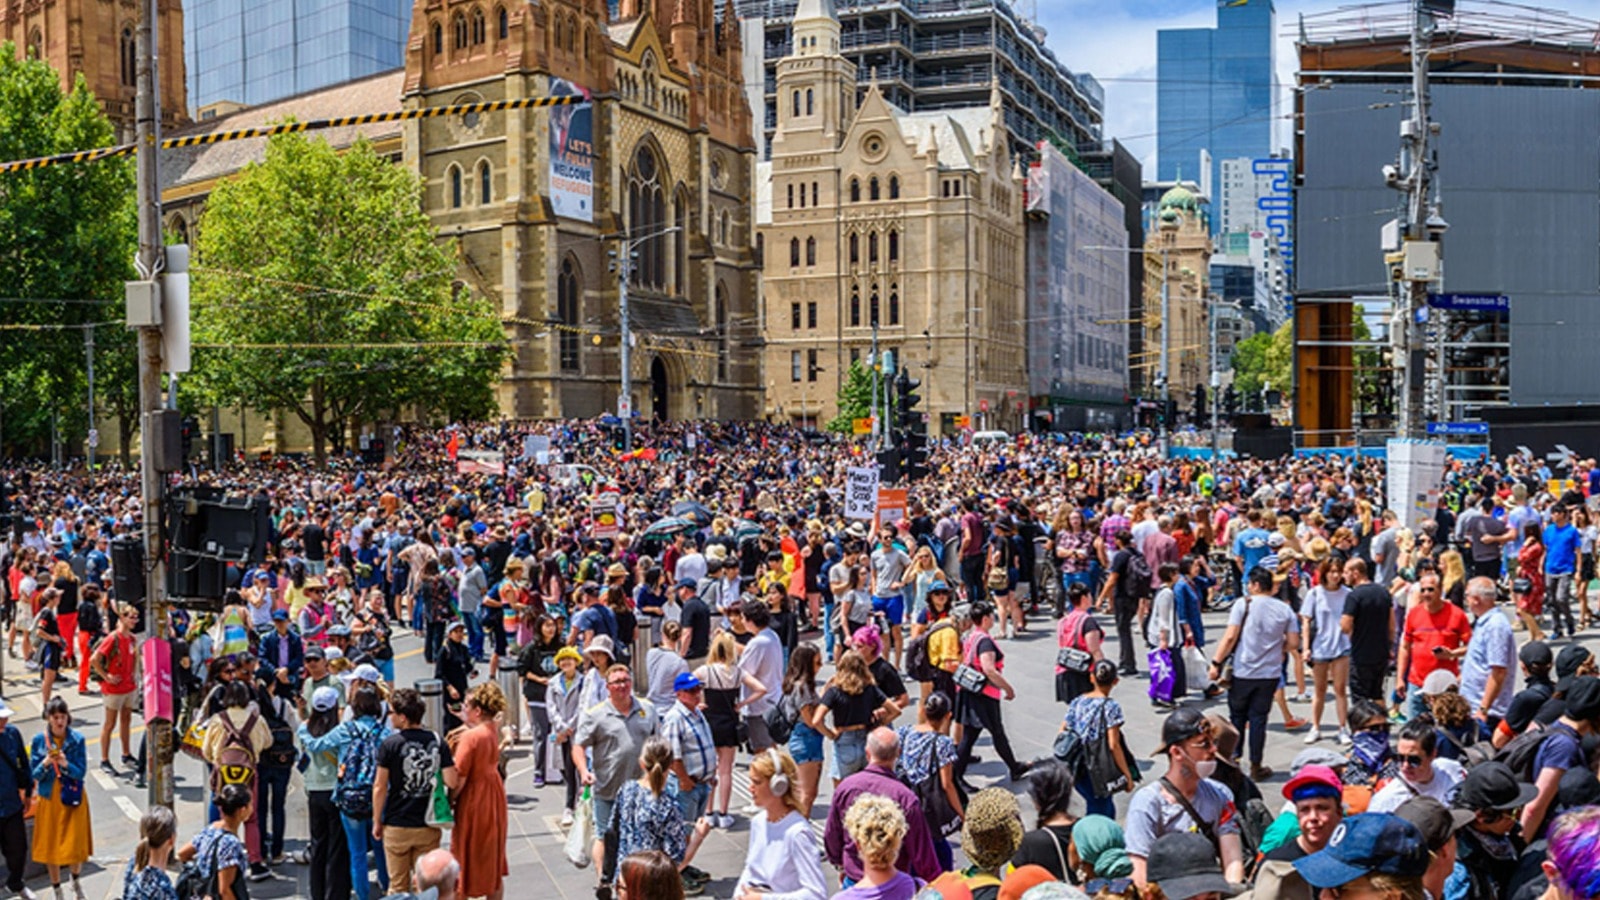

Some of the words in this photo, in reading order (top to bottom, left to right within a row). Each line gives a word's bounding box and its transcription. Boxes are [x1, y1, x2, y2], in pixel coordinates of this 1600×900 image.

[569, 138, 592, 155] LET'S
[553, 163, 591, 183] WELCOME
[551, 176, 591, 196] REFUGEES
[1452, 295, 1495, 305] Swanston
[1497, 296, 1506, 306] St
[852, 491, 871, 501] GOOD
[848, 500, 858, 511] TO
[862, 501, 876, 512] ME
